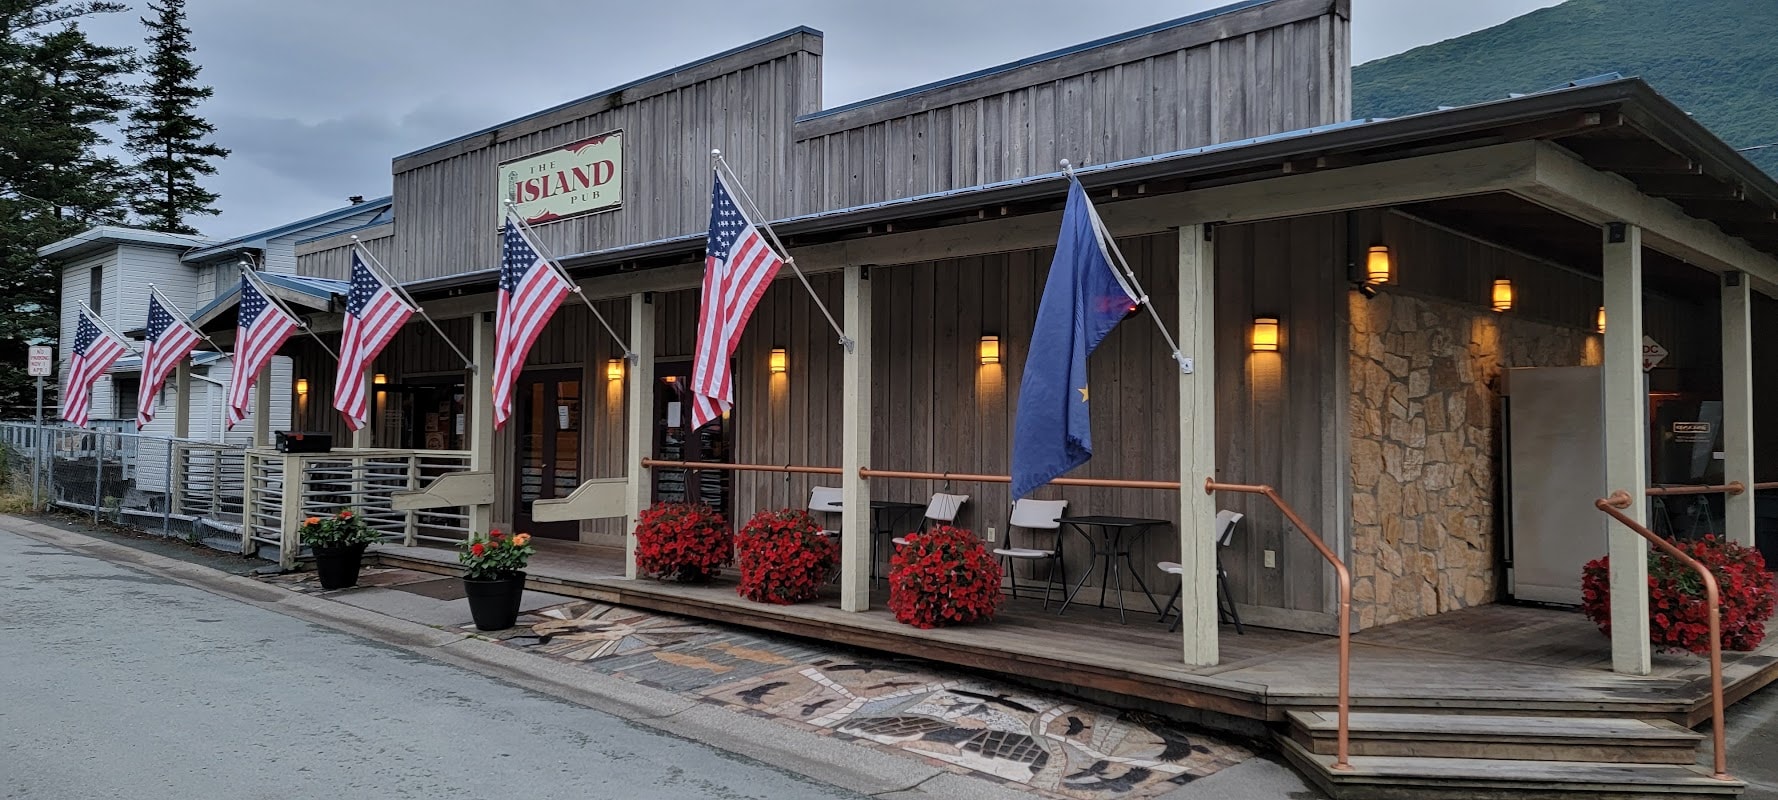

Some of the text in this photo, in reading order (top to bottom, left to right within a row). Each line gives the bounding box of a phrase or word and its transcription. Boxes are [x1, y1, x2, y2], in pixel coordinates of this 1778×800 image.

[529, 161, 556, 174] THE
[515, 159, 615, 205] ISLAND
[570, 190, 600, 204] PUB
[1642, 345, 1659, 354] DC
